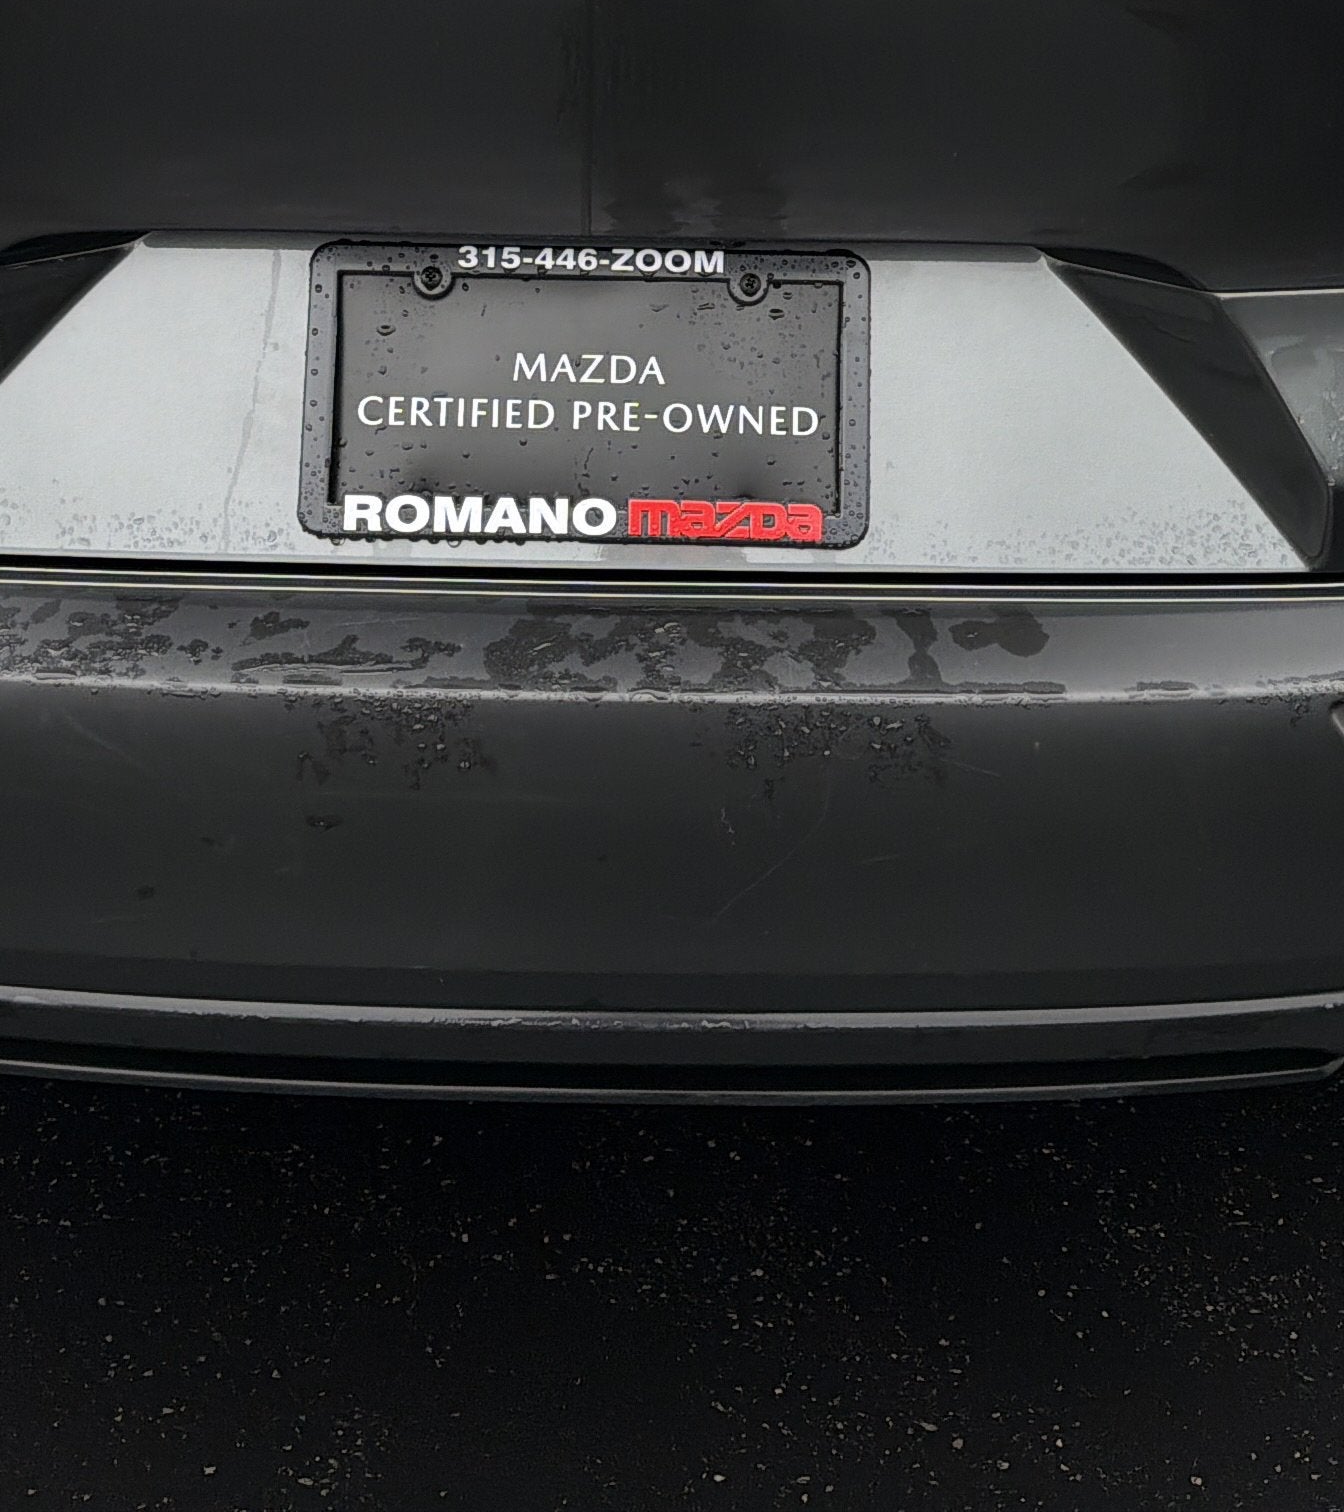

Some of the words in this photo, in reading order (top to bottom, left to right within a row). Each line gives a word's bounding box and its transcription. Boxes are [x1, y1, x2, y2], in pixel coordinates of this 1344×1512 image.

[457, 245, 725, 274] 315-446-ZOOM
[512, 352, 666, 385] MAZDA
[357, 395, 555, 429] CERTIFIED
[572, 400, 819, 437] PRE-OWNED
[343, 494, 617, 536] ROMANO
